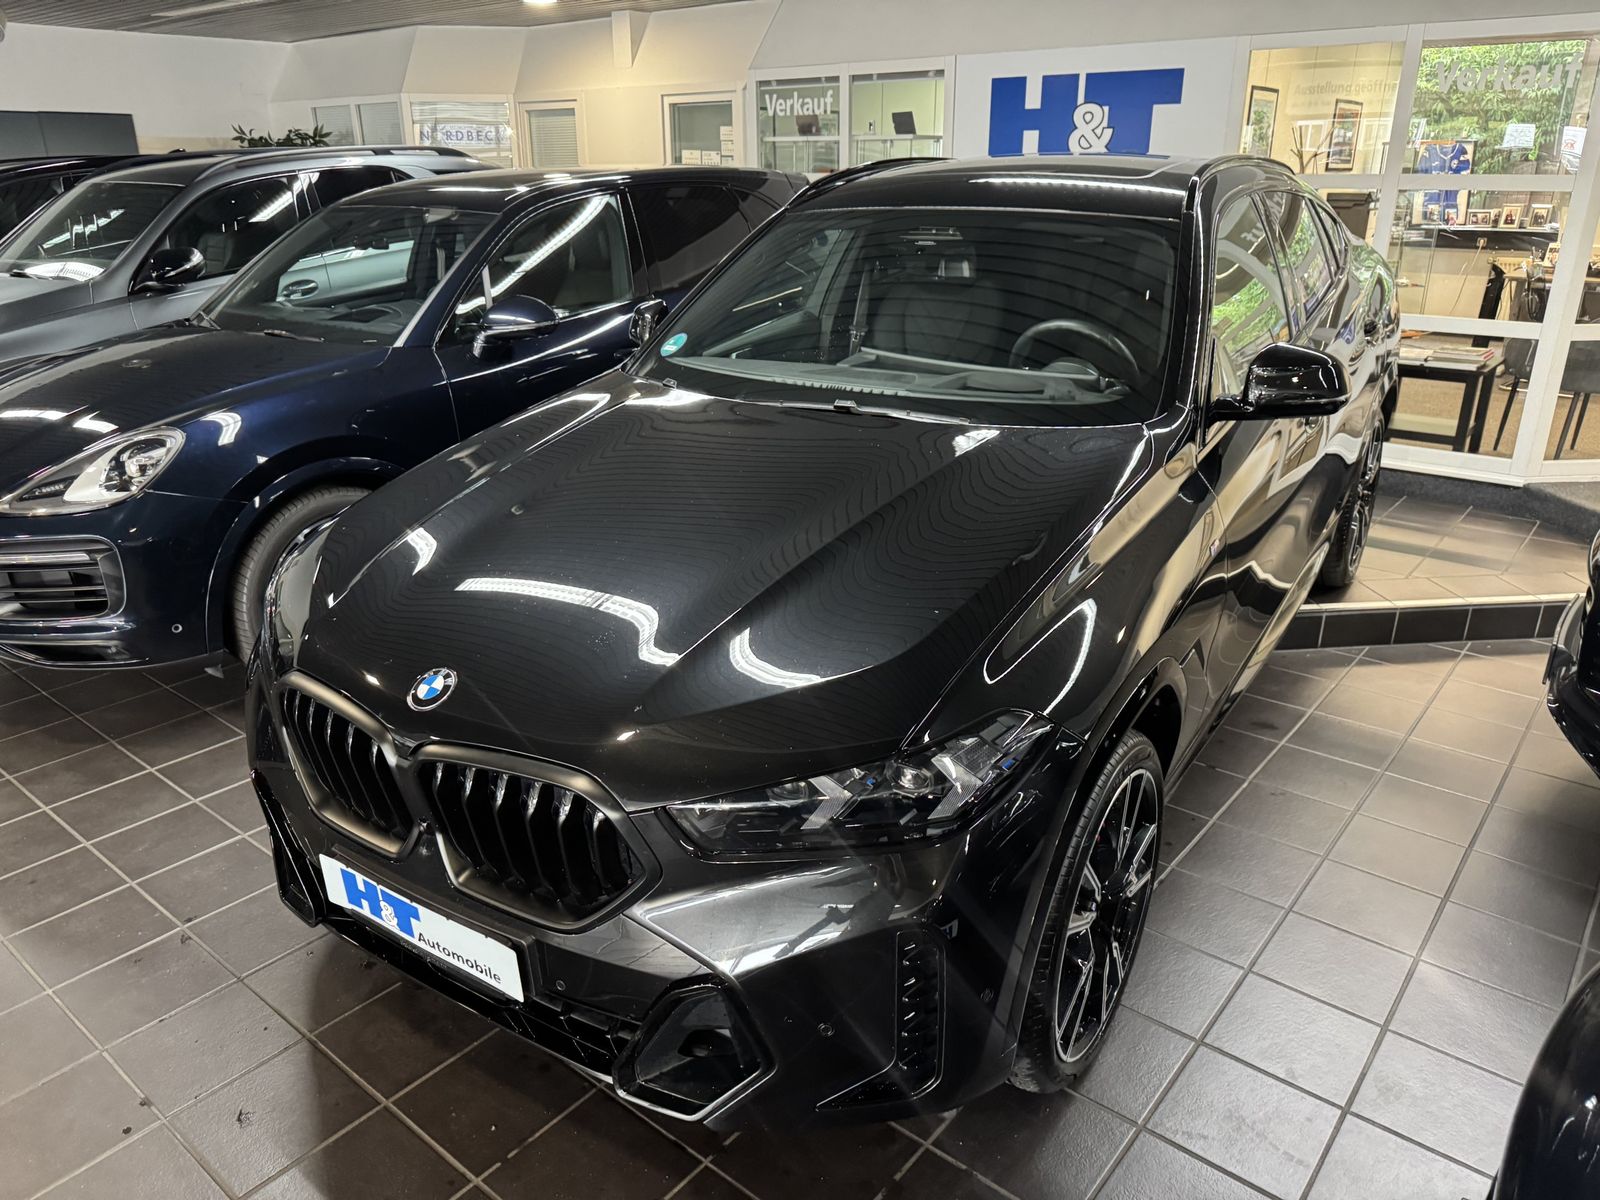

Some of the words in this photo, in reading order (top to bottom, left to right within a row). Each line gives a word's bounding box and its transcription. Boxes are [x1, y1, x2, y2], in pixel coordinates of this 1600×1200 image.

[1437, 52, 1584, 92] Verkauf
[765, 89, 833, 117] Verkauf
[988, 68, 1185, 155] H&T
[420, 130, 505, 142] NRDBEC
[340, 868, 421, 938] H&T
[418, 932, 502, 984] Automobile
